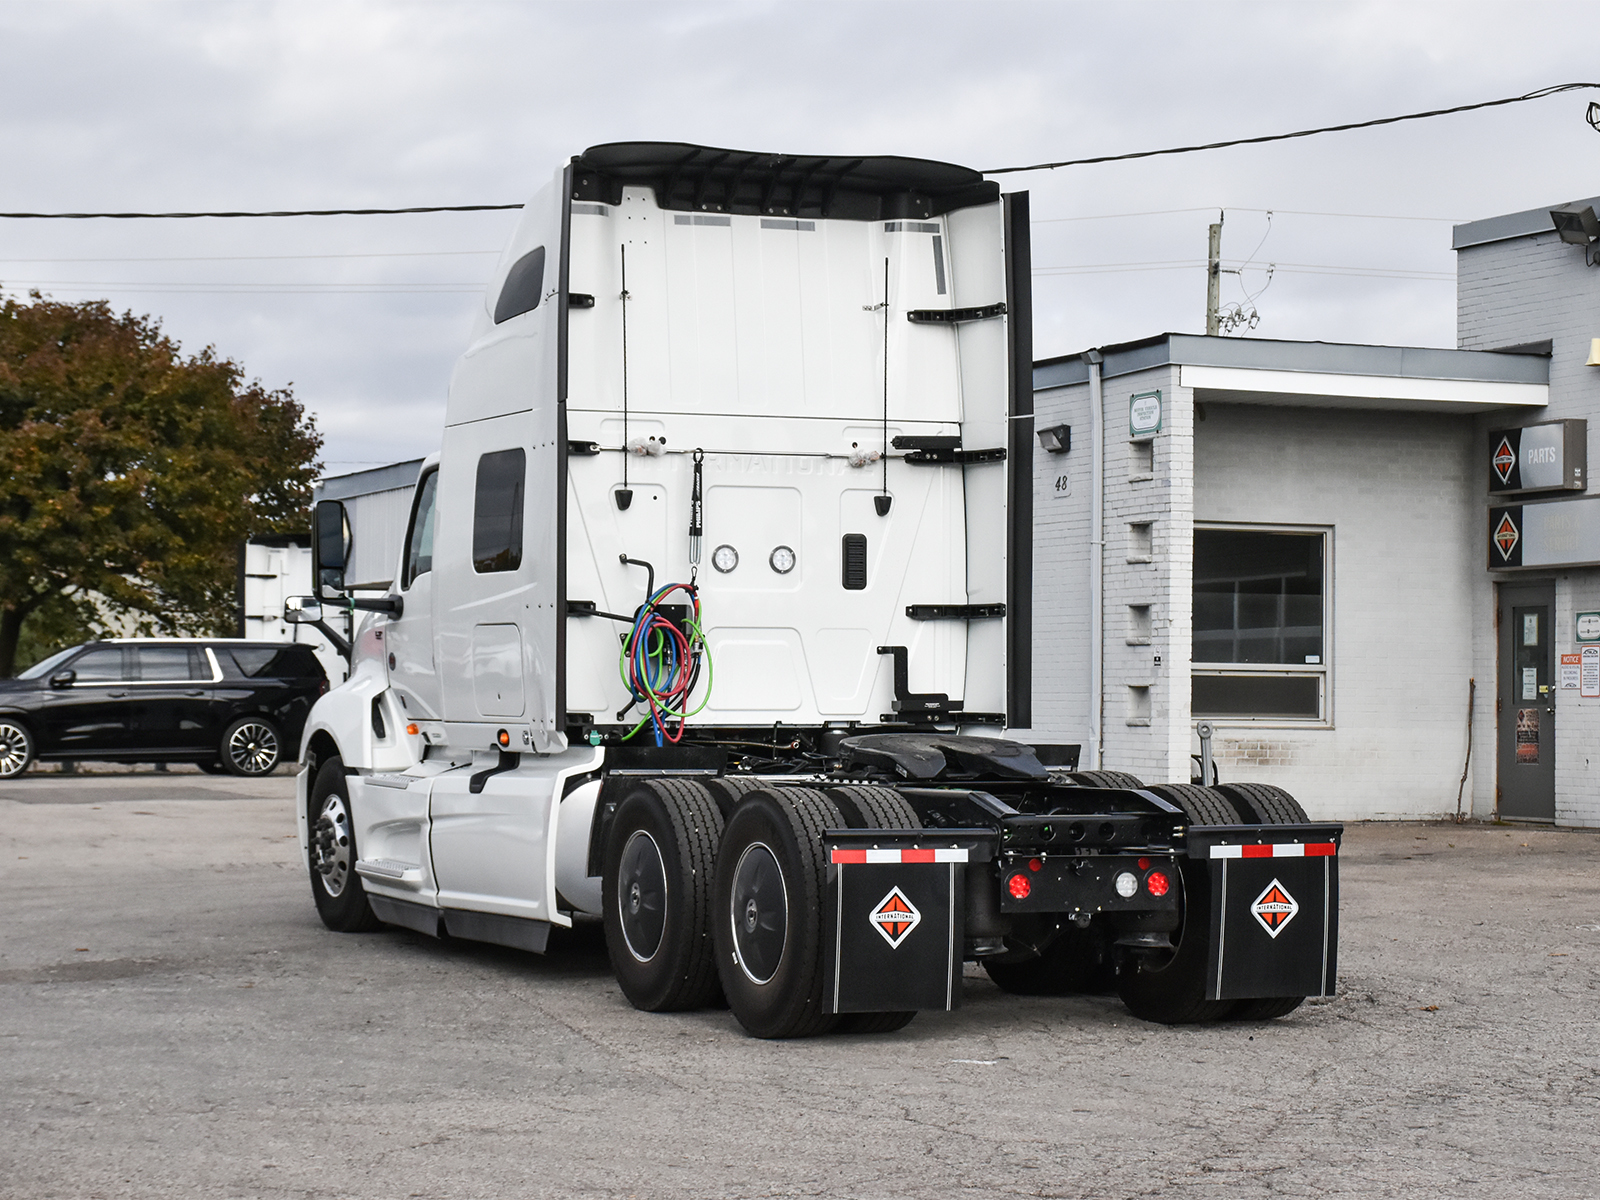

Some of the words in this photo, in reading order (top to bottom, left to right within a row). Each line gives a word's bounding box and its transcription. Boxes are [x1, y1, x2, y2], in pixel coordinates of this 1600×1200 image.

[1528, 446, 1556, 465] PARTS
[1055, 475, 1068, 491] 48
[1563, 655, 1579, 663] NOTICE
[875, 912, 914, 920] INTERNATIONAL
